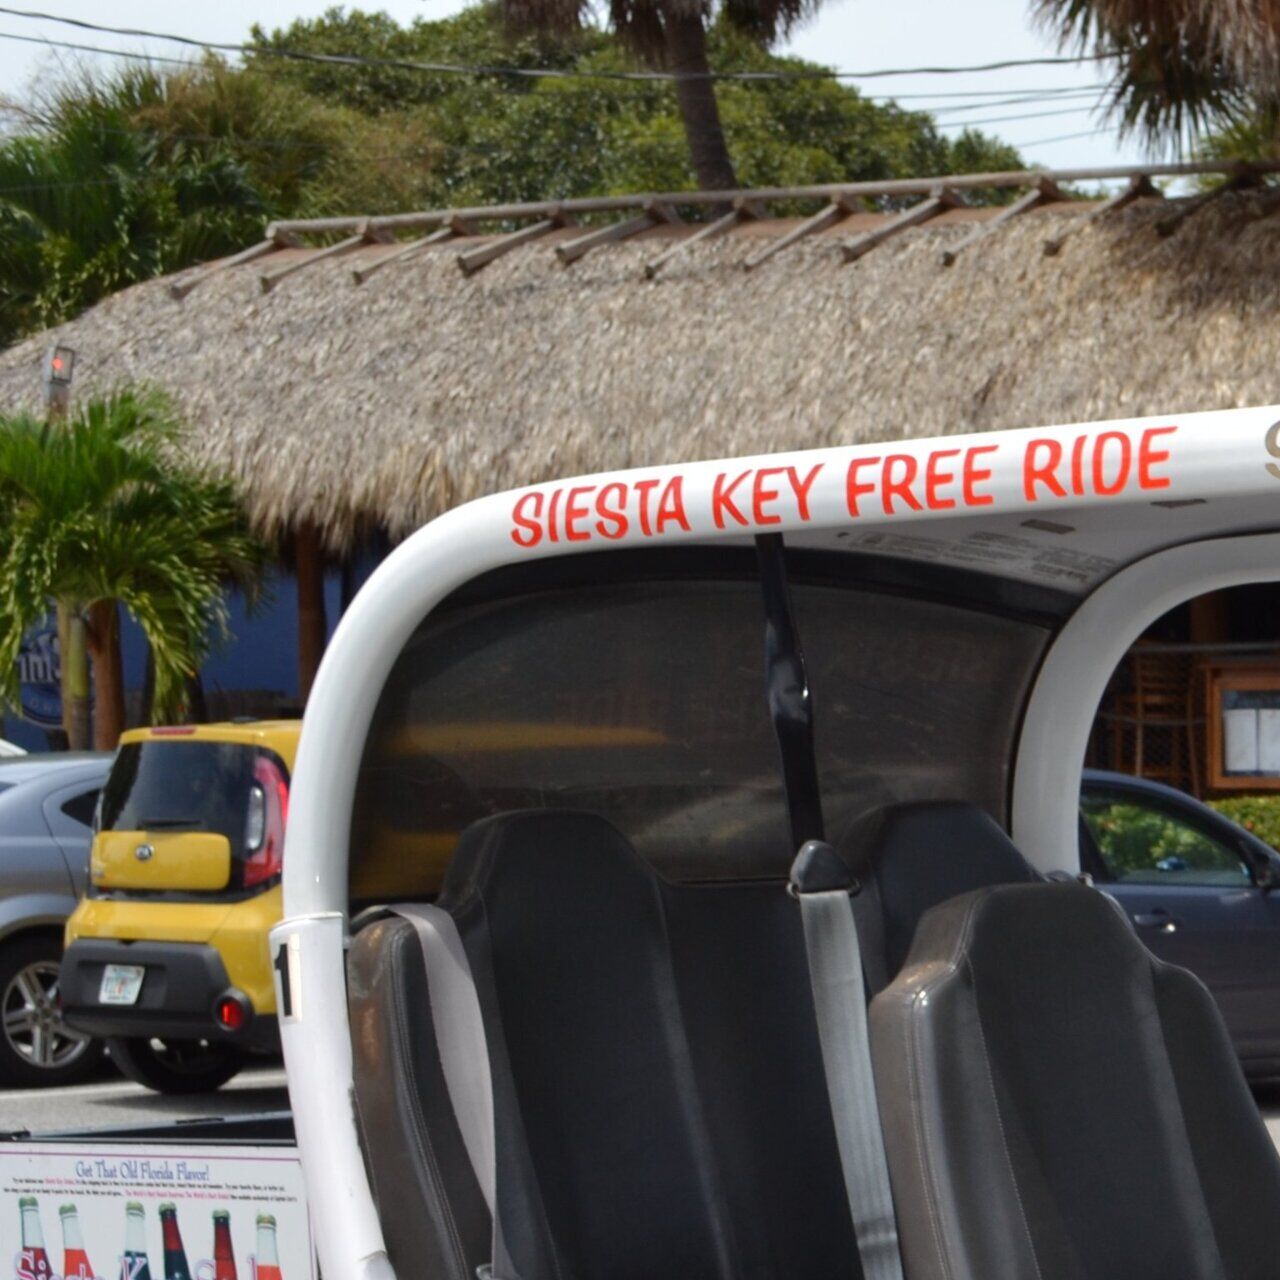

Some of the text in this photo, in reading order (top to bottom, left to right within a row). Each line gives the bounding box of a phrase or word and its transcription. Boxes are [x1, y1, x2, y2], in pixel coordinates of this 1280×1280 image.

[510, 475, 690, 549] SIESTA
[711, 463, 829, 530] KEY
[845, 444, 1000, 518] FREE
[1022, 425, 1179, 502] RIDE
[76, 1161, 95, 1177] Get
[96, 1161, 119, 1178] That
[120, 1161, 138, 1179] Old
[140, 1162, 175, 1180] Florida
